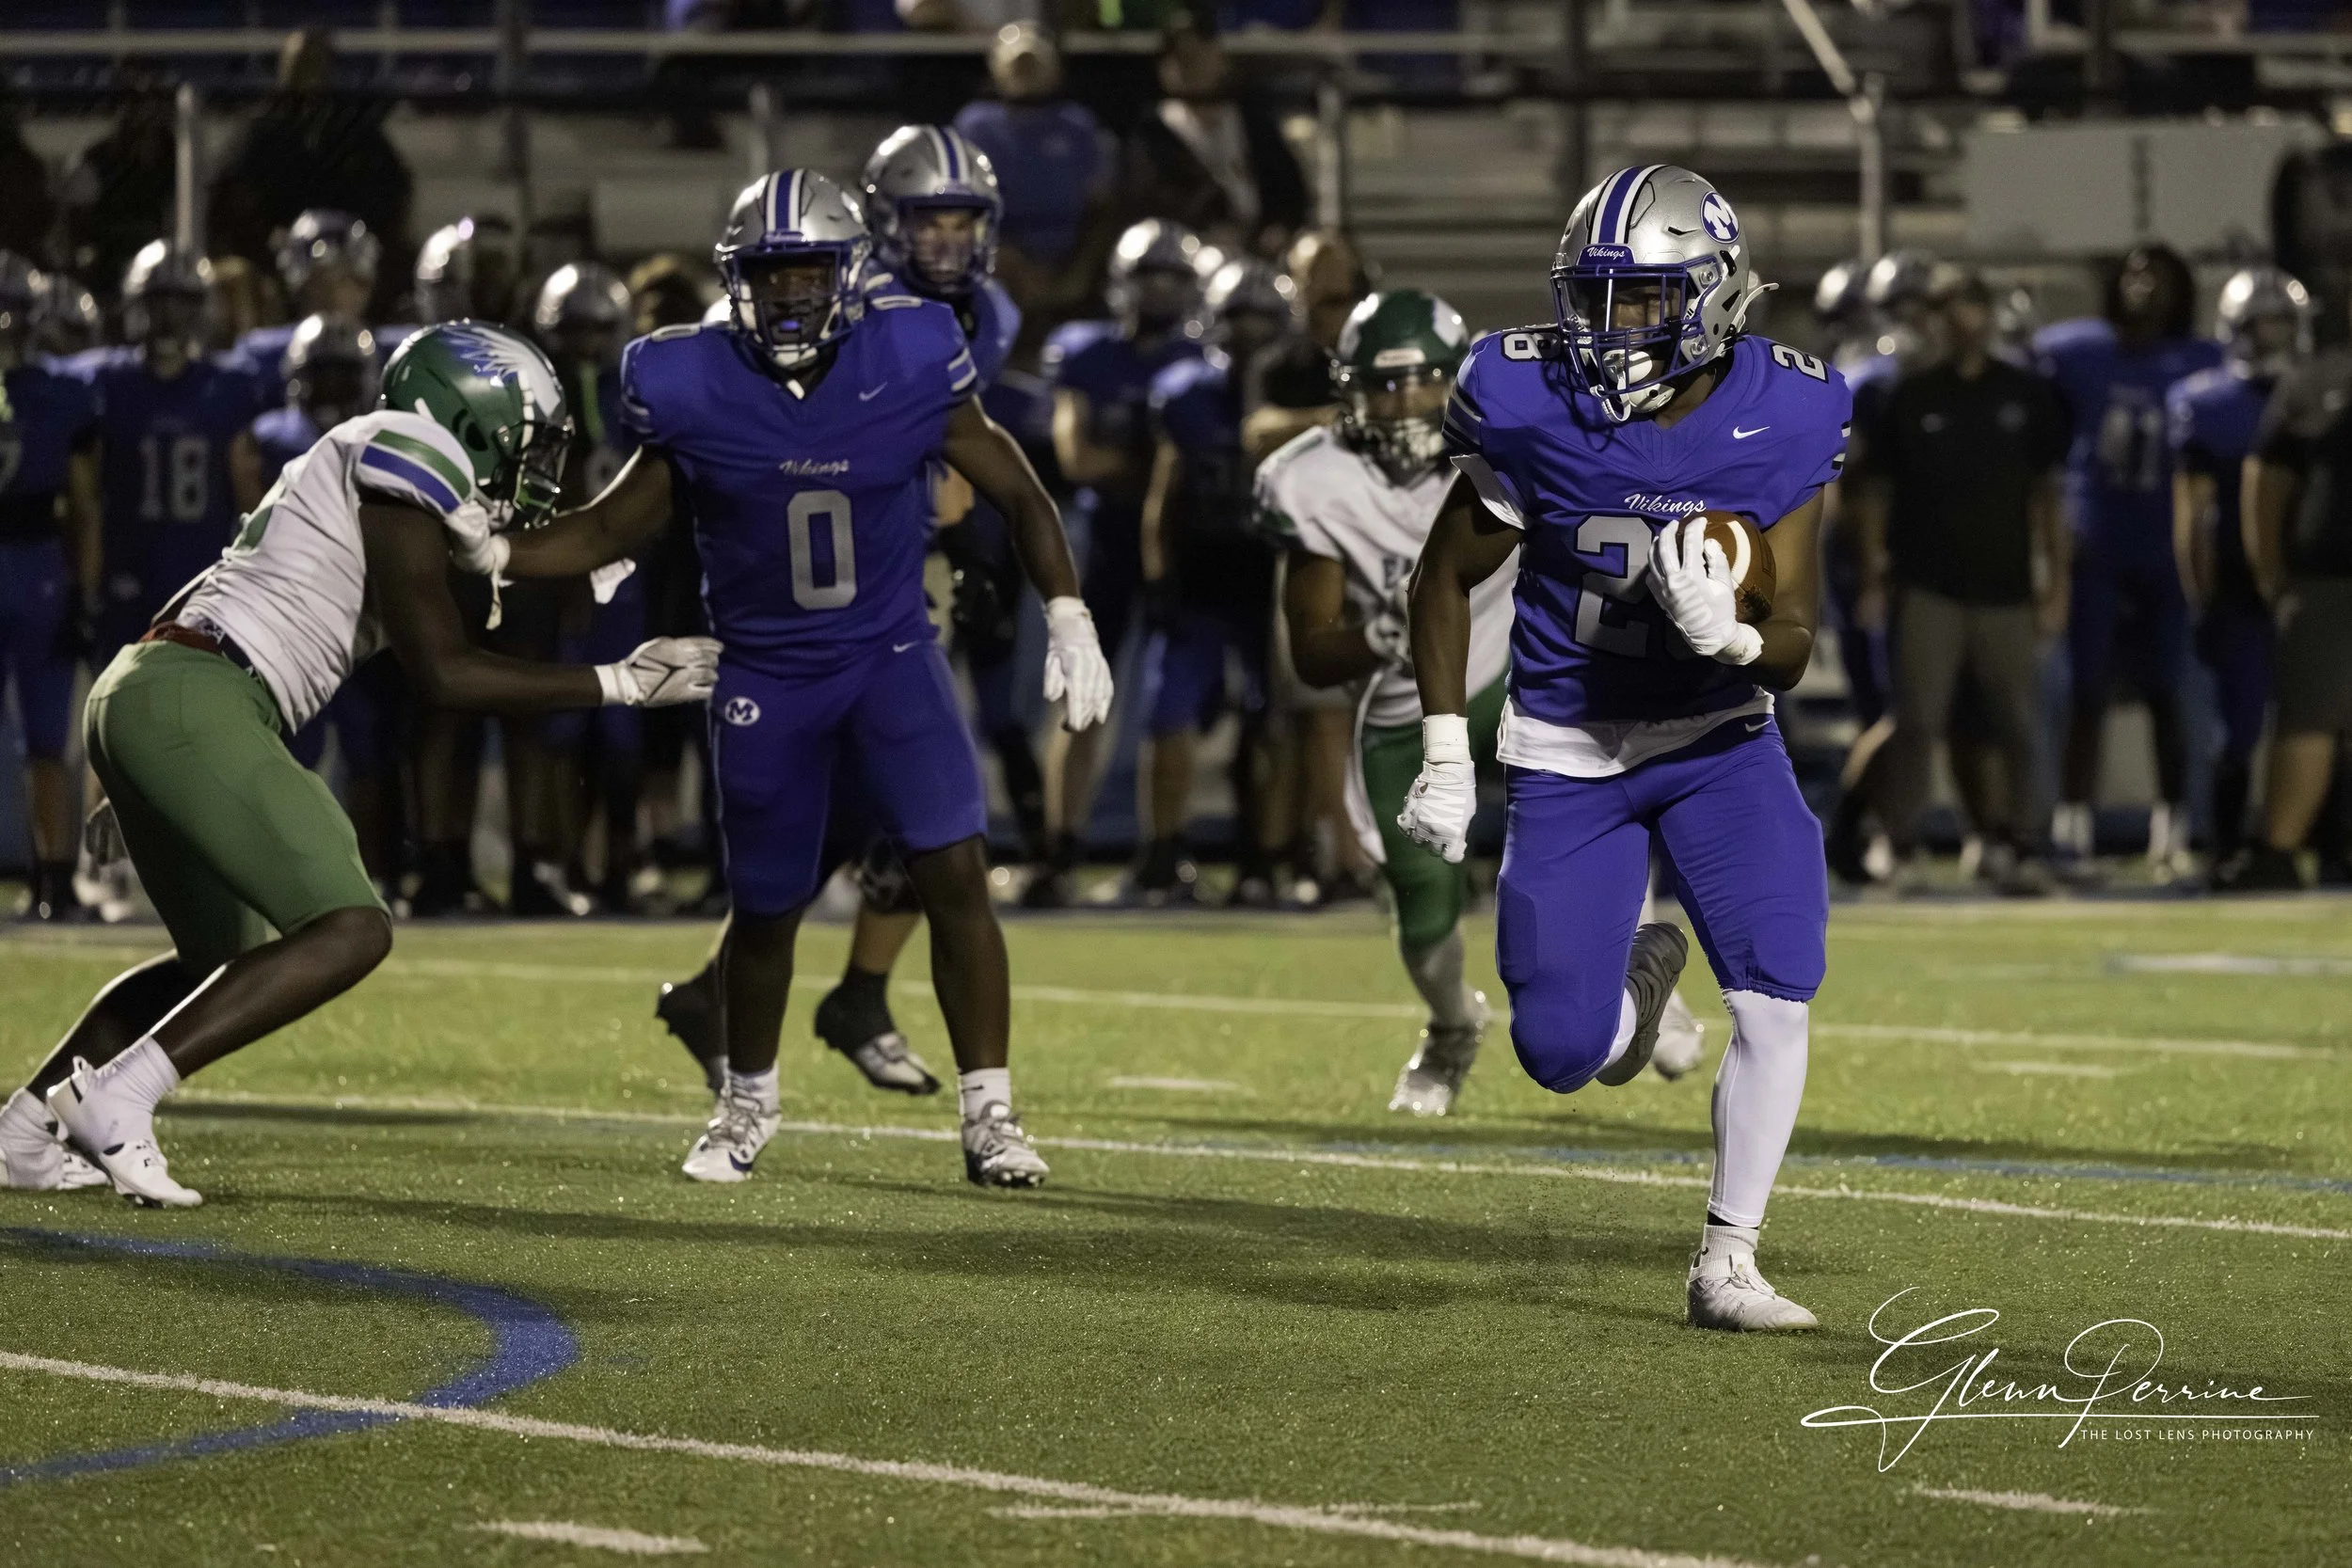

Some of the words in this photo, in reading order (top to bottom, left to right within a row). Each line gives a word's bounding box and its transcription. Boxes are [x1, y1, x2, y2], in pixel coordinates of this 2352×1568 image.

[1702, 193, 1739, 241] M
[1586, 246, 1627, 260] Vikings
[140, 435, 209, 522] 18
[779, 458, 850, 476] Vikings
[1624, 493, 1707, 517] Vikings
[787, 488, 858, 610] 0
[728, 700, 755, 723] M
